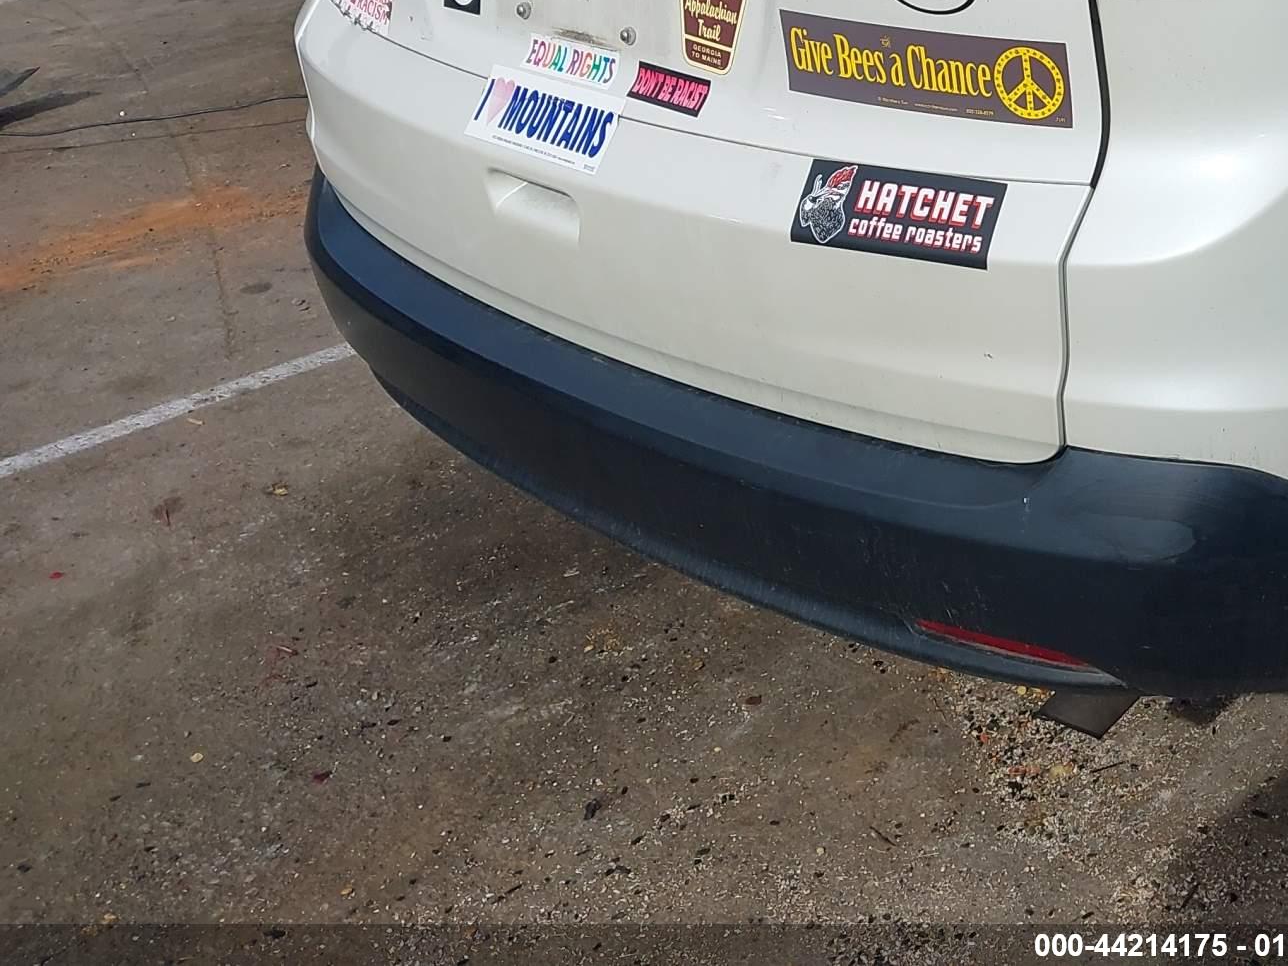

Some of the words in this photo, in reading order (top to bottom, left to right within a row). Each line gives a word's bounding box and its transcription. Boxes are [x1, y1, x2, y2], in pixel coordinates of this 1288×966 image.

[692, 44, 722, 58] GEORGIA
[697, 19, 720, 41] Trail
[525, 39, 568, 73] EQUAL
[566, 48, 616, 84] RIGHTS
[691, 51, 700, 60] TO
[701, 53, 722, 67] MAINE
[789, 26, 833, 76] Give
[833, 33, 887, 85] Bees
[889, 52, 906, 87] a
[906, 43, 993, 98] Chance
[632, 67, 663, 96] DON'T
[659, 75, 675, 102] BE
[672, 80, 709, 111] RACIST
[474, 78, 496, 121] I
[497, 85, 615, 158] MOUNTAINS
[854, 179, 995, 229] HATCHET
[848, 216, 903, 242] coffee
[904, 227, 983, 254] roasters
